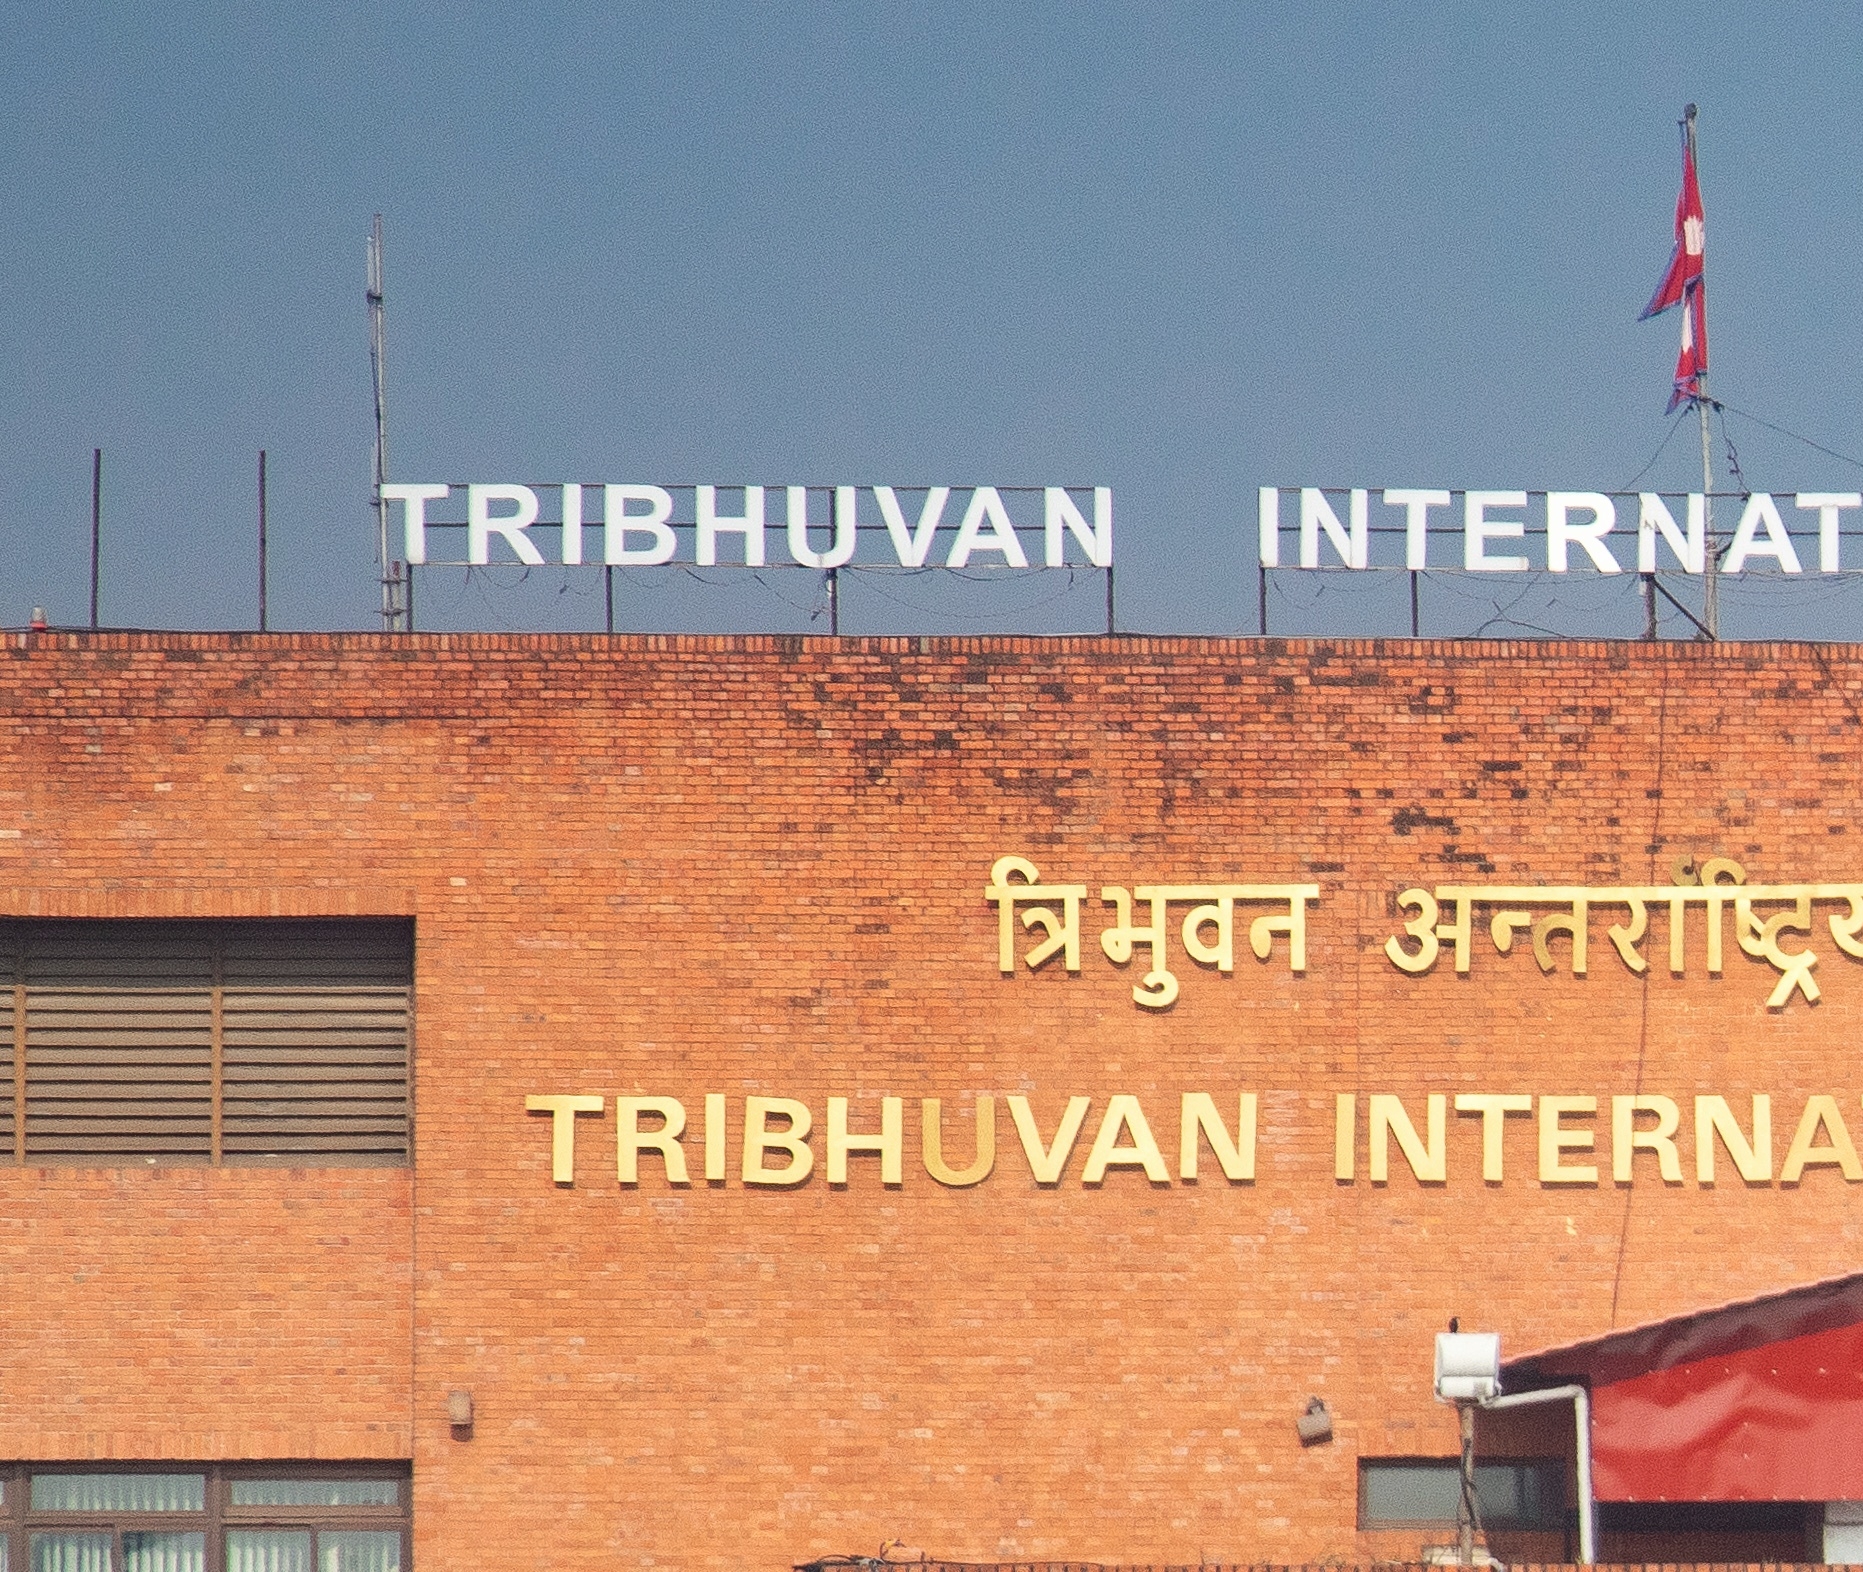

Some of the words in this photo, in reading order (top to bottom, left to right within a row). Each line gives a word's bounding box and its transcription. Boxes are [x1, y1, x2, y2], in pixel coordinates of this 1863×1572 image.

[382, 484, 1113, 569] TRIBHUVAN
[984, 853, 1321, 1008] त्रिभुवन
[523, 1092, 1259, 1187] TRIBHUVAN
